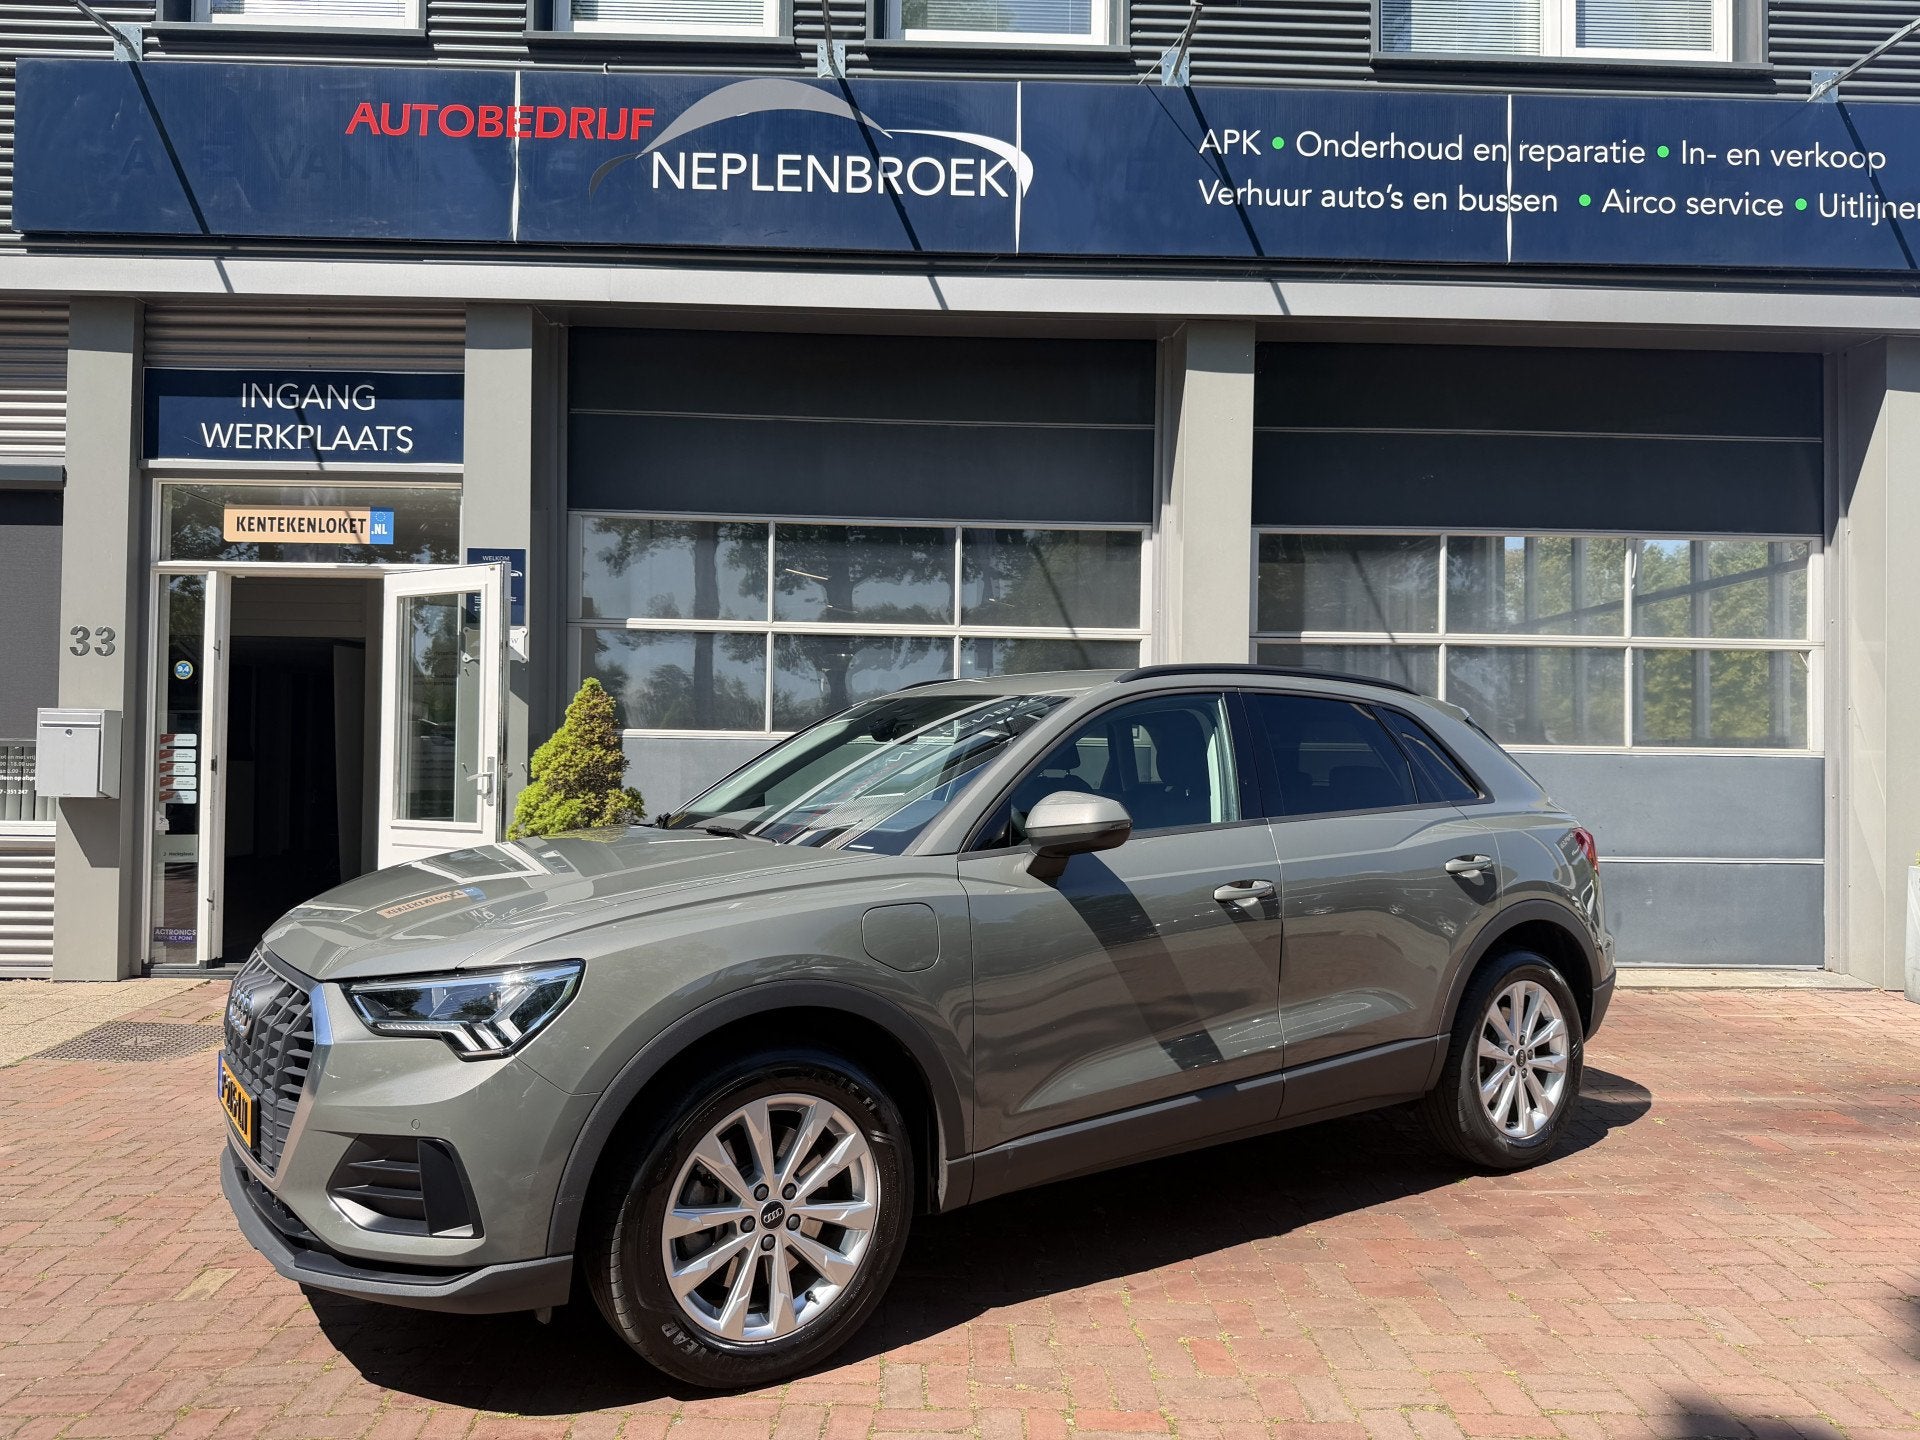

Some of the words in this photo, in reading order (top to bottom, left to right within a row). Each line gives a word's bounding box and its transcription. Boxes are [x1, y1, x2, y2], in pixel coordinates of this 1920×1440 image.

[345, 102, 655, 140] AUTOBEDRIJF
[1199, 128, 1262, 156] APK
[1296, 130, 1463, 161] Onderhoud
[1473, 143, 1508, 162] en
[1519, 138, 1646, 172] reparatie
[1681, 139, 1718, 166] In-
[1726, 148, 1760, 166] en
[1770, 141, 1886, 178] verkoop
[651, 151, 1009, 198] NEPLENBROEK
[1198, 178, 1312, 206] Verhuur
[1320, 183, 1404, 210] auto's
[1413, 191, 1447, 211] en
[1458, 184, 1558, 213] bussen
[1601, 188, 1677, 215] Airco
[1686, 191, 1784, 217] service
[1818, 191, 1920, 226] Uitlijne
[240, 382, 376, 411] INGANG
[200, 422, 414, 454] WERKPLAATS
[236, 516, 366, 534] KENTEKENLOKET
[69, 625, 116, 657] 33
[154, 928, 197, 936] ACTRONICS
